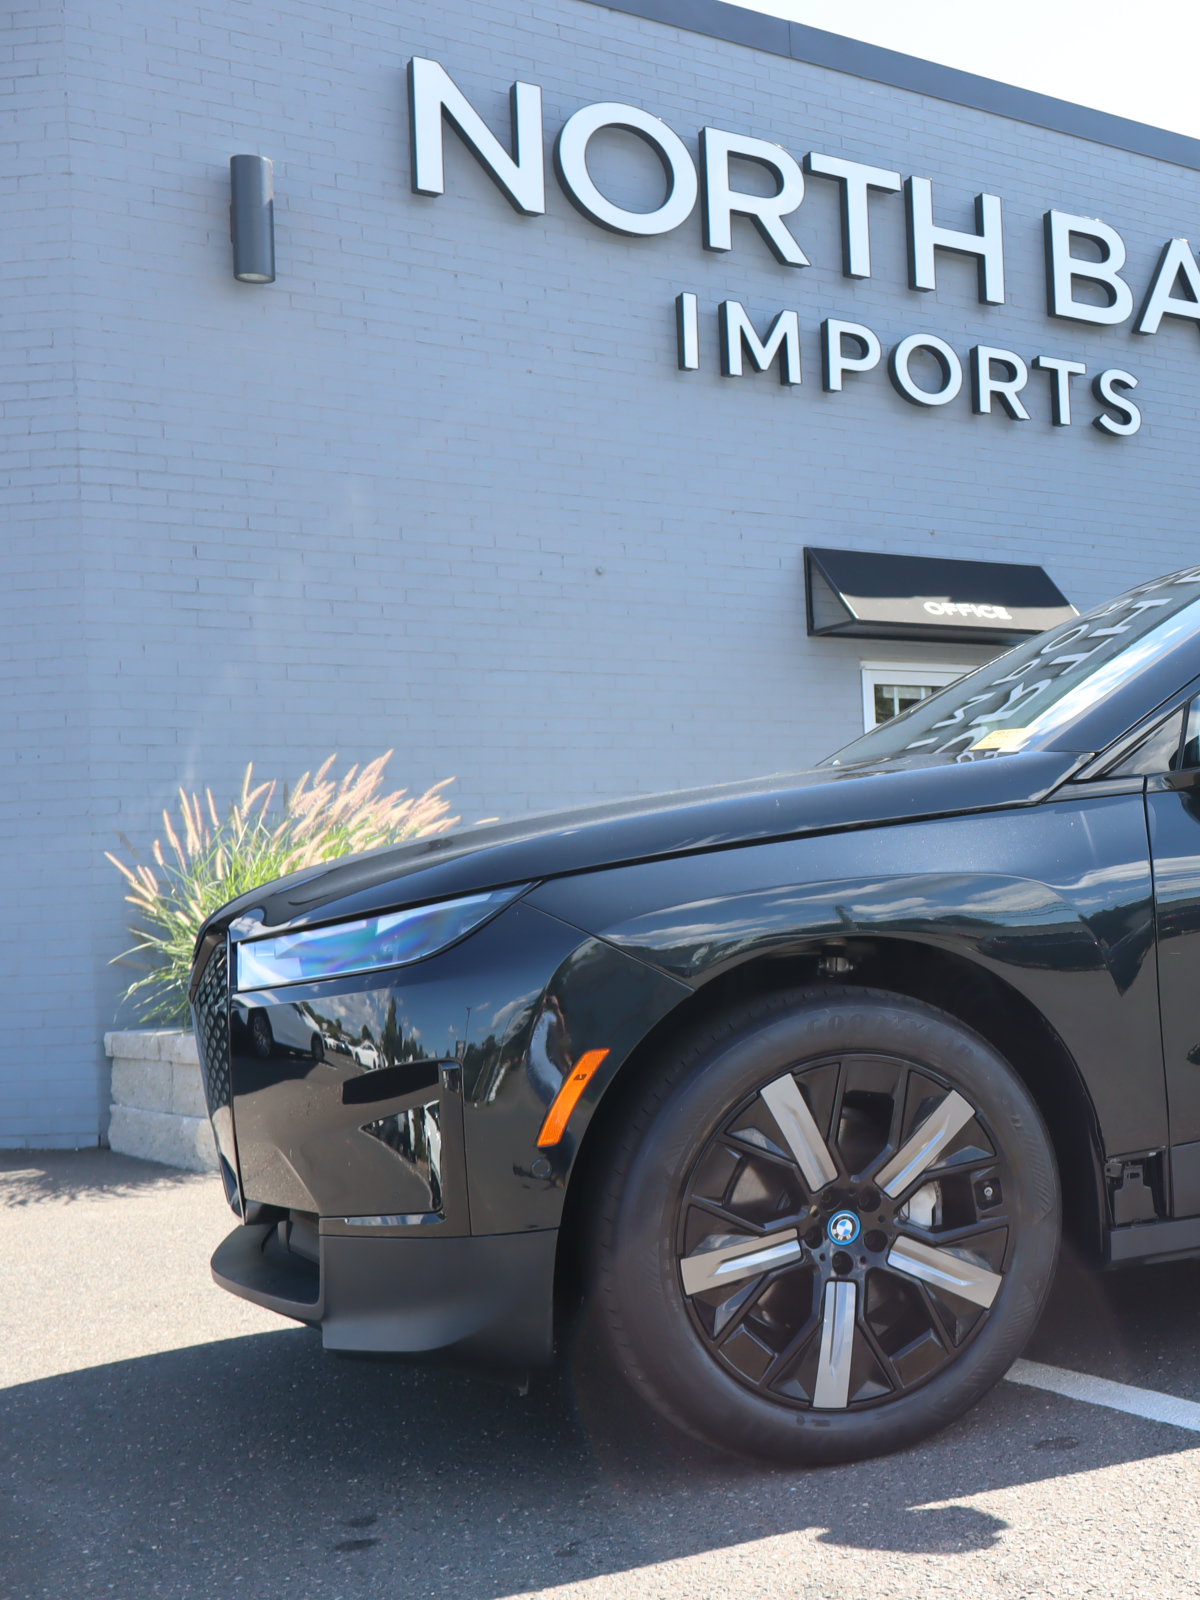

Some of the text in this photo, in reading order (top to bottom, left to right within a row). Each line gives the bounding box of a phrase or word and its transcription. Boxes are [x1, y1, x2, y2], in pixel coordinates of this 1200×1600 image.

[409, 56, 1005, 306] NORTH
[677, 292, 1142, 436] IMPORTS
[922, 600, 1013, 621] OFFICE
